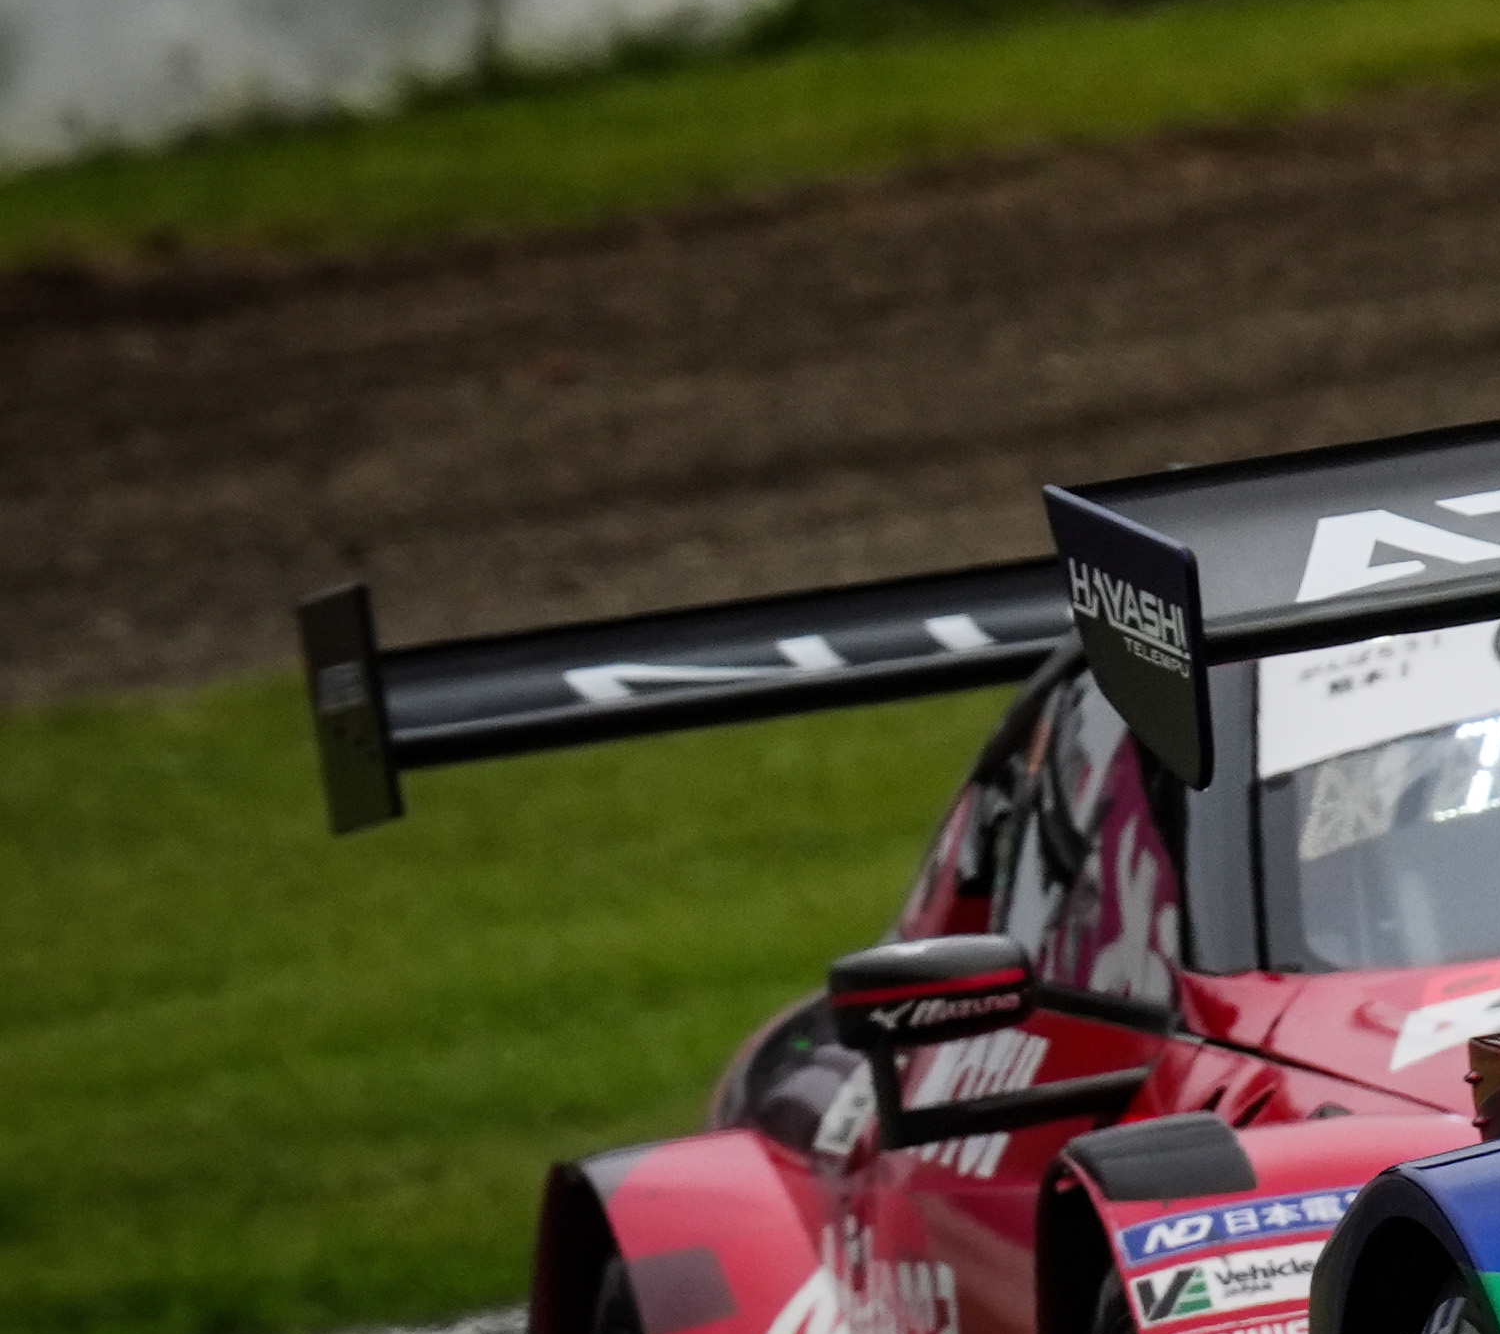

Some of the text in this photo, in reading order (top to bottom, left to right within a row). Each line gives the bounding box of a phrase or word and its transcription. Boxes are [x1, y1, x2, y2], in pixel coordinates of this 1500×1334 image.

[1068, 556, 1191, 659] HAYASHI
[1223, 1190, 1360, 1234] 日本電
